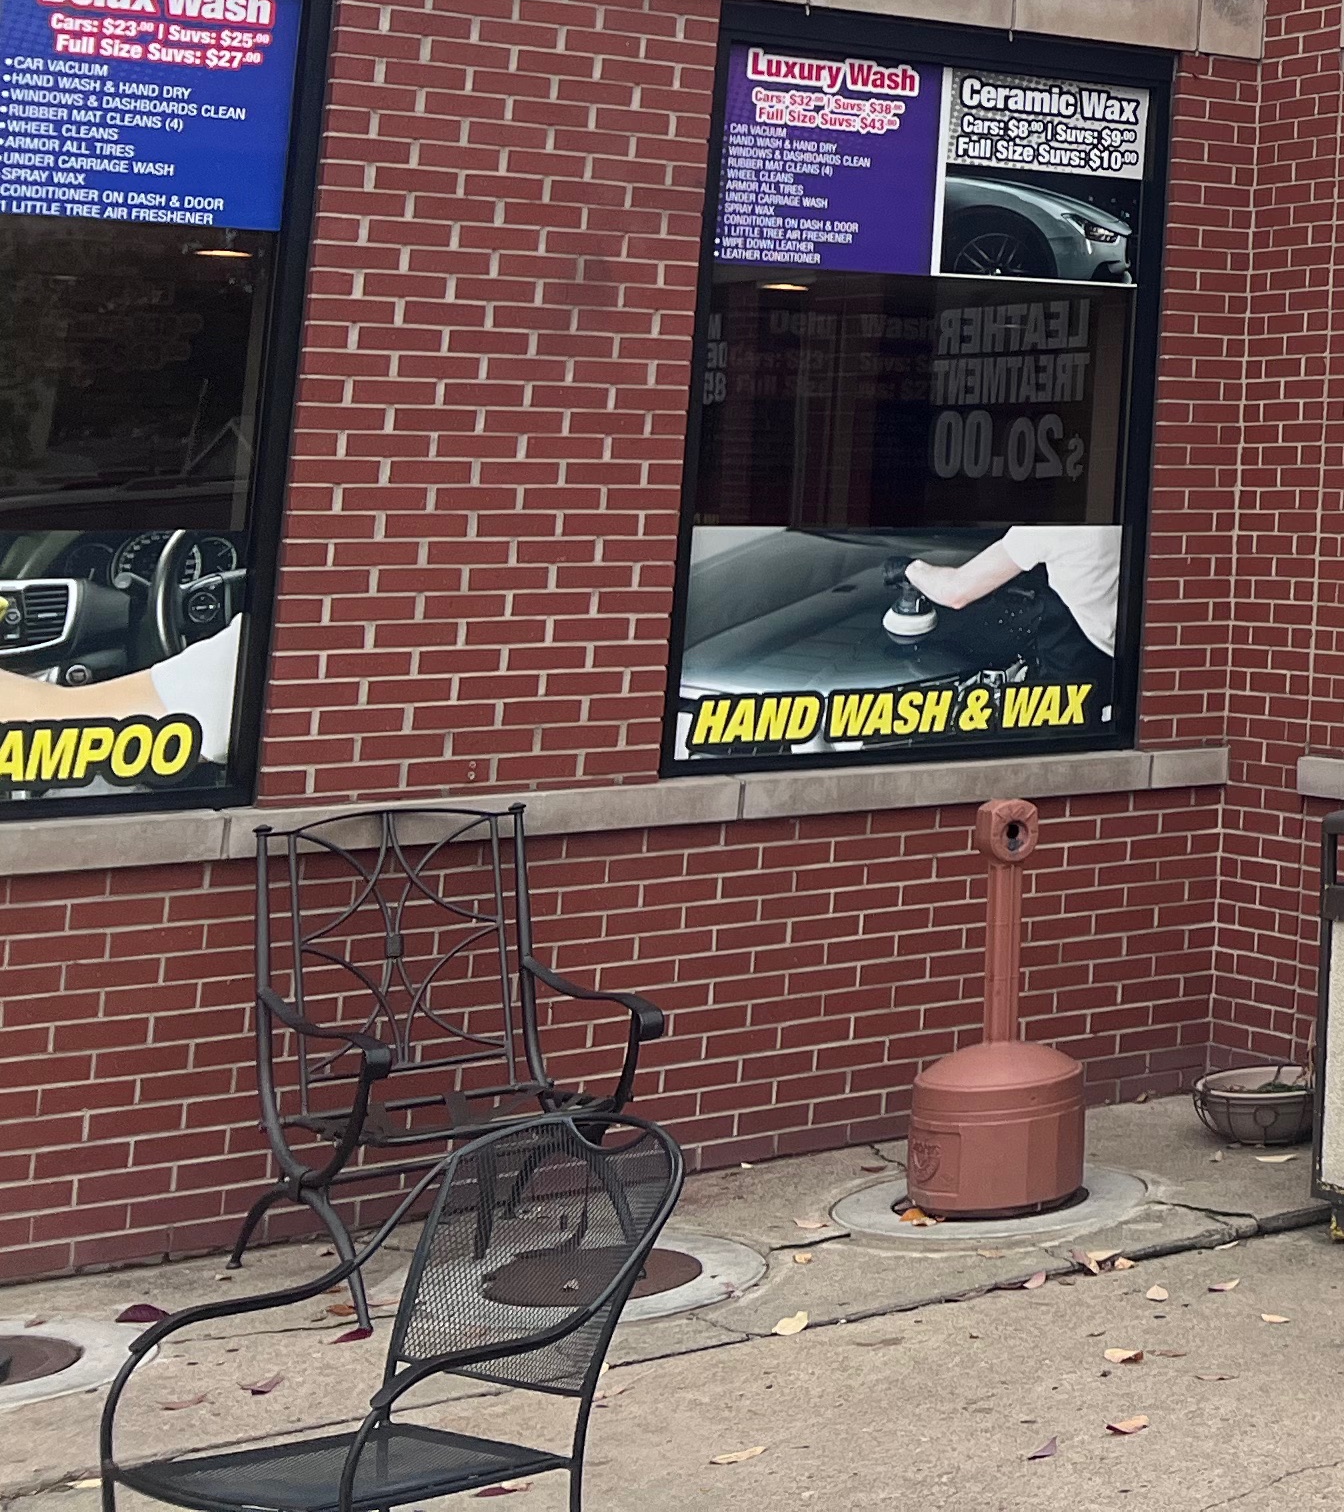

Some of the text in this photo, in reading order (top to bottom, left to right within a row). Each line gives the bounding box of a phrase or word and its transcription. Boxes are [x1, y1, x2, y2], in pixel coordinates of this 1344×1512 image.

[51, 14, 98, 33] Cars:
[168, 25, 216, 45] Suvs:
[56, 34, 94, 54] Full
[101, 38, 142, 58] Size
[147, 43, 201, 65] Suvs:
[14, 57, 109, 76] CAR VACUUM
[752, 52, 916, 92] Luxury Wash
[12, 72, 191, 99] HAND WASH & HAND DRY
[10, 88, 246, 120] WINDOWS & DASHBOARDS CLEAN
[755, 90, 786, 104] Cars:
[834, 98, 866, 113] Suvs:
[962, 77, 1138, 122] Ceramic Wax
[9, 104, 184, 132] RUBBER MAT CLEANS (4)
[758, 107, 782, 121] Full
[788, 110, 816, 124] Size
[820, 113, 856, 128] Suvs:
[7, 120, 119, 140] WHEEL CLEANS
[730, 123, 786, 136] CAR VACUUM
[962, 115, 1004, 136] Cars:
[1056, 124, 1098, 144] Suvs:
[4, 136, 134, 157] ARMOR ALL TIRES
[729, 135, 837, 153] HAND WASH HAND DRY
[958, 137, 991, 158] Full
[996, 139, 1034, 162] Size
[1038, 144, 1086, 167] Suvs:
[4, 152, 174, 176] UNDER CARRIAGE WASH
[728, 146, 870, 168] WINDOWS DASHBOARDS CLEAN
[728, 158, 833, 176] RUBBER MAT CLEANS (4)
[1, 167, 86, 185] SPRAY WAX
[727, 168, 794, 183] WHEEL CLEANS
[726, 180, 804, 195] ARMOR ALL TIRES
[102, 190, 123, 204] ON
[128, 192, 166, 207] DASH
[170, 194, 180, 208] &
[184, 196, 224, 210] DOOR
[724, 203, 774, 216] SPRAY WAX
[726, 191, 828, 208] UNDER CARRIAGE WASH
[12, 201, 213, 225] LITTLE TREE AIR FRESHENER
[724, 214, 858, 232] CONDITIONER ON DASH DOOR
[722, 236, 814, 252] WIPE DOWN LEATHER
[731, 226, 852, 244] LITTLE TREE AIR FRESHENER
[722, 248, 820, 264] LEATHER CONDITIONER
[692, 683, 1092, 745] HAND WASH & WAX
